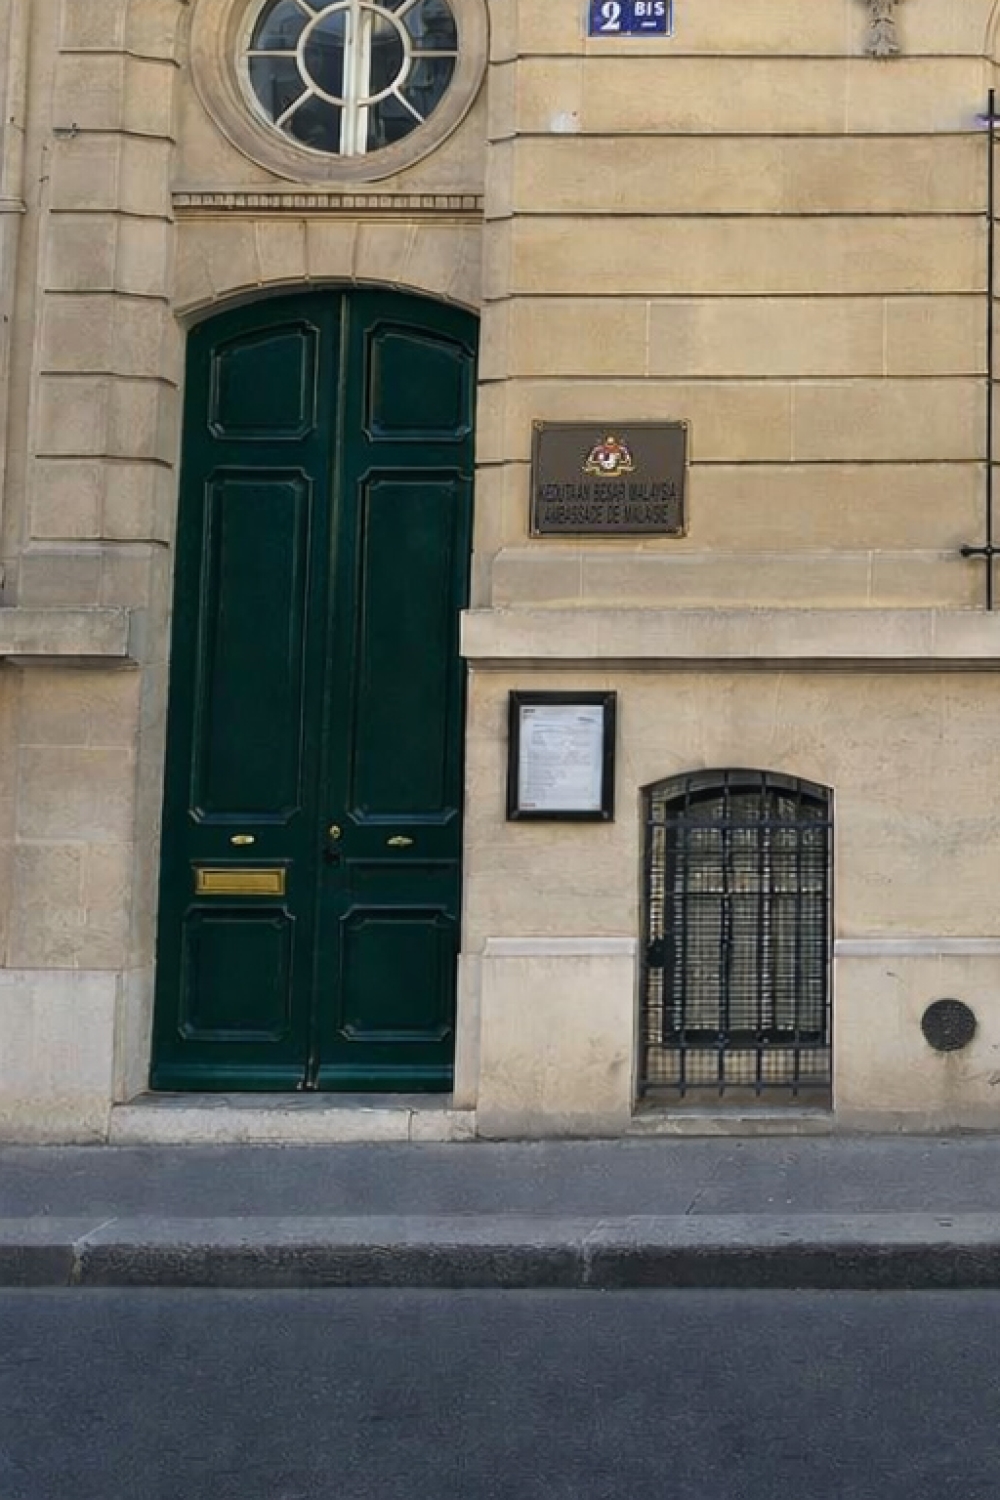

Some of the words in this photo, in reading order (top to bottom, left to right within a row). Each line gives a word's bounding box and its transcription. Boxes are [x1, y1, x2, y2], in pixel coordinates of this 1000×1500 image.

[601, 1, 621, 30] 2
[634, 1, 665, 16] BIS
[593, 483, 626, 503] BESAR
[542, 504, 604, 524] AMBASSADE
[607, 504, 620, 524] DE
